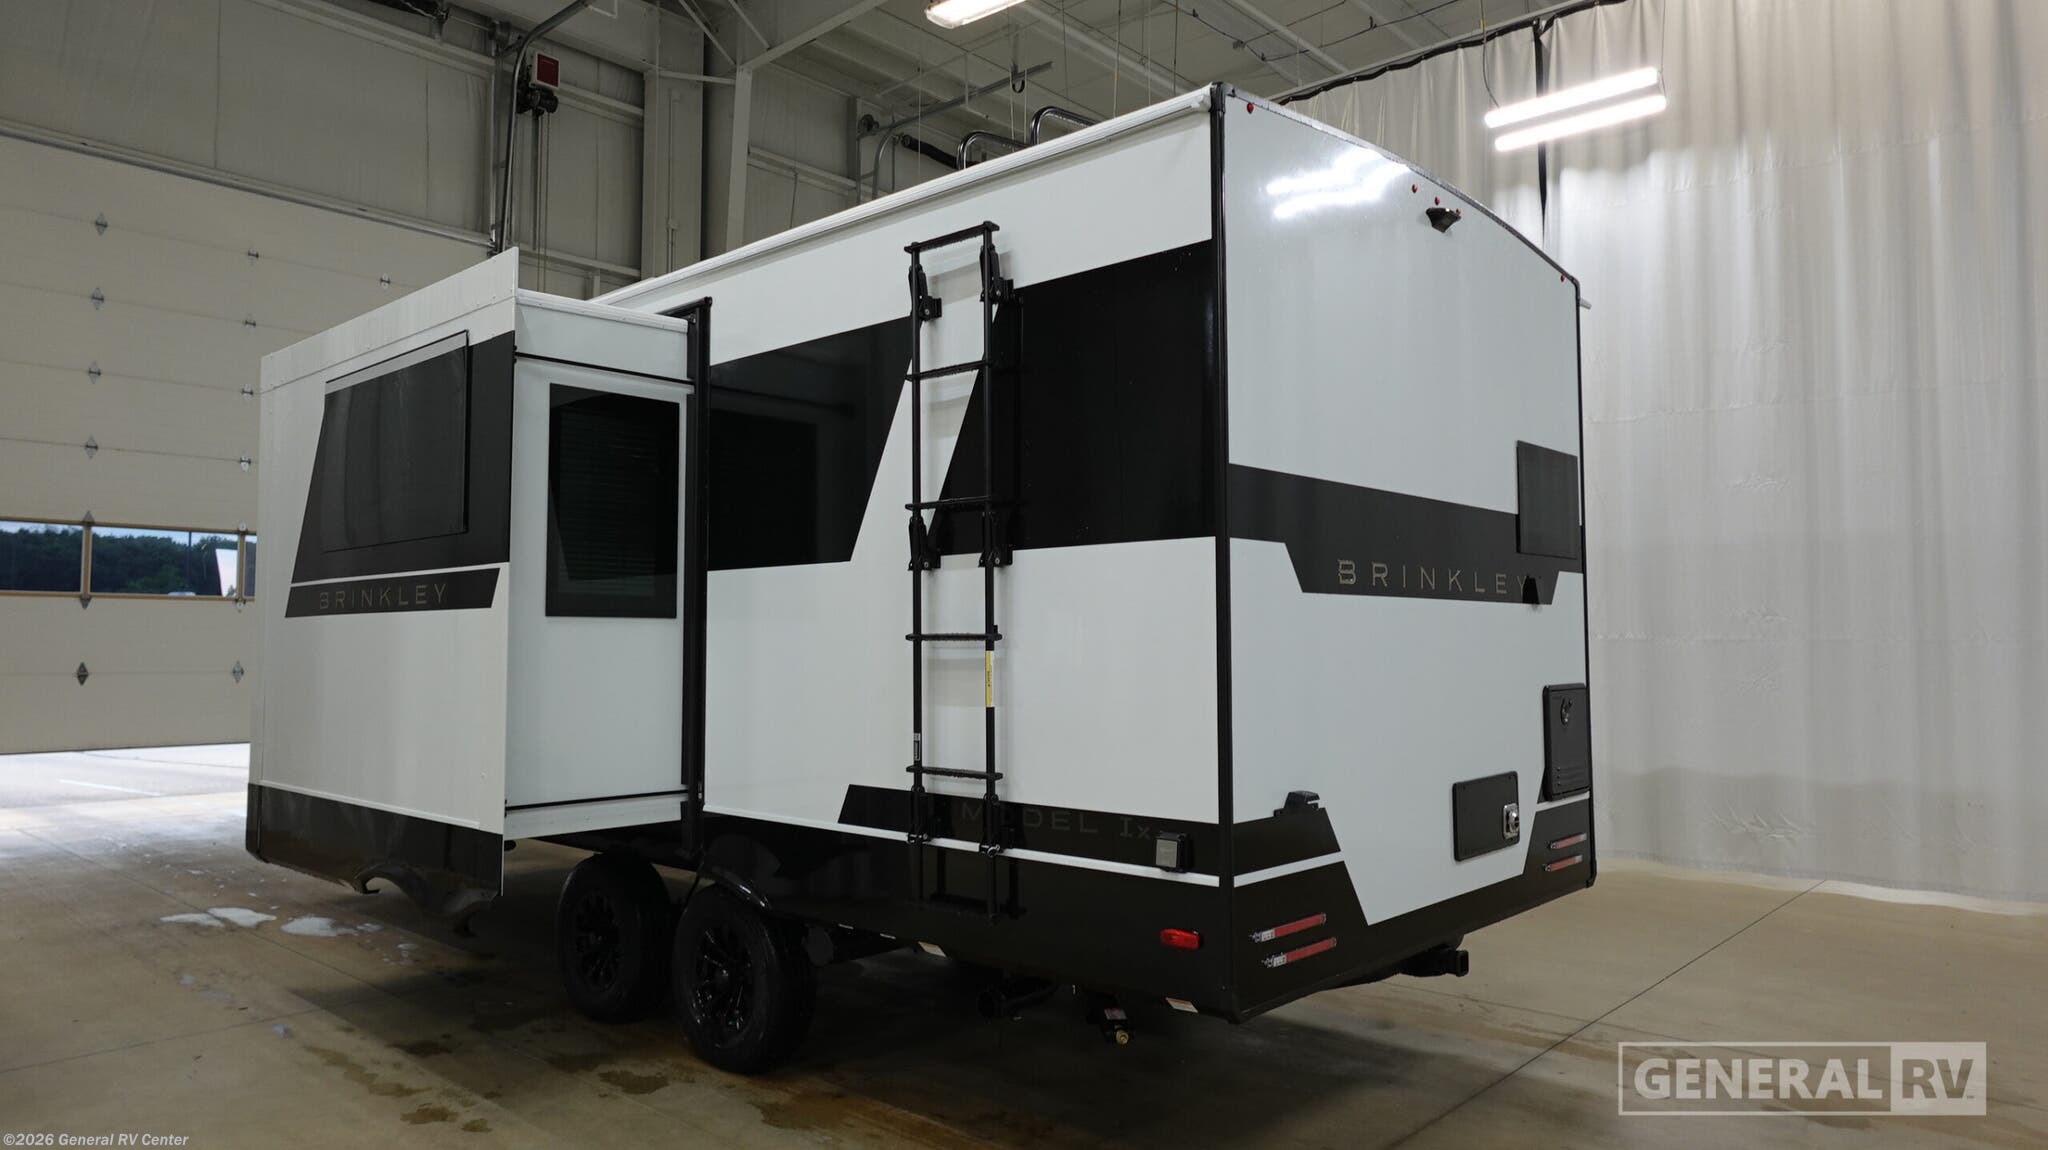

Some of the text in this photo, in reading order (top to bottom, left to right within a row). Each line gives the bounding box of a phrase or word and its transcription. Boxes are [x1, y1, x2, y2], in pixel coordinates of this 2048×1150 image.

[1337, 559, 1527, 599] BRINKLEY
[319, 583, 447, 610] BRINKLEY
[961, 802, 1098, 834] MDEL
